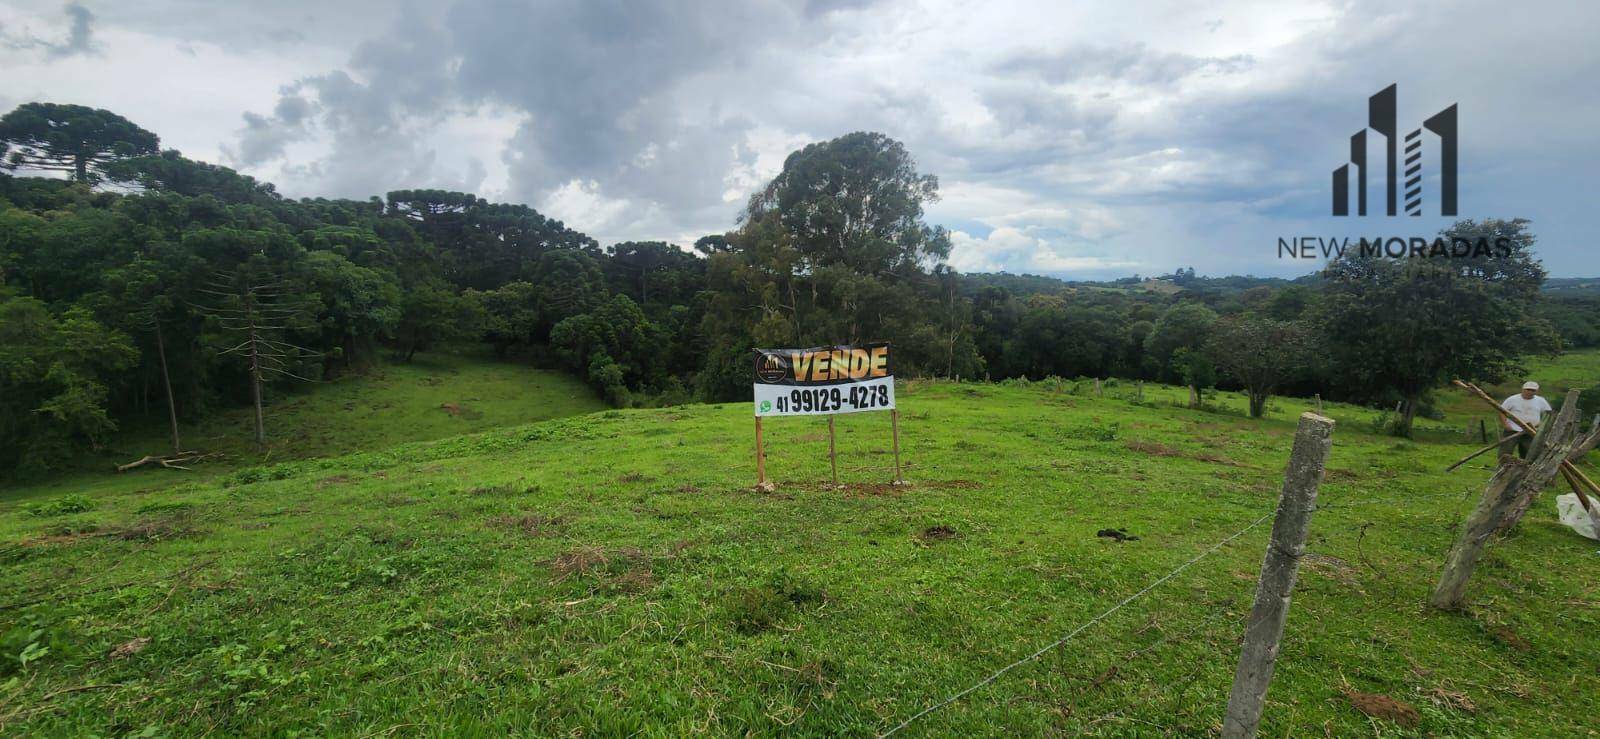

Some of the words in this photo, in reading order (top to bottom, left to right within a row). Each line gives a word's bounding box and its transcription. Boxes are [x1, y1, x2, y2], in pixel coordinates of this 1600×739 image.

[791, 346, 888, 382] VENDE
[776, 396, 789, 413] 41
[790, 384, 889, 413] 99129-4278
